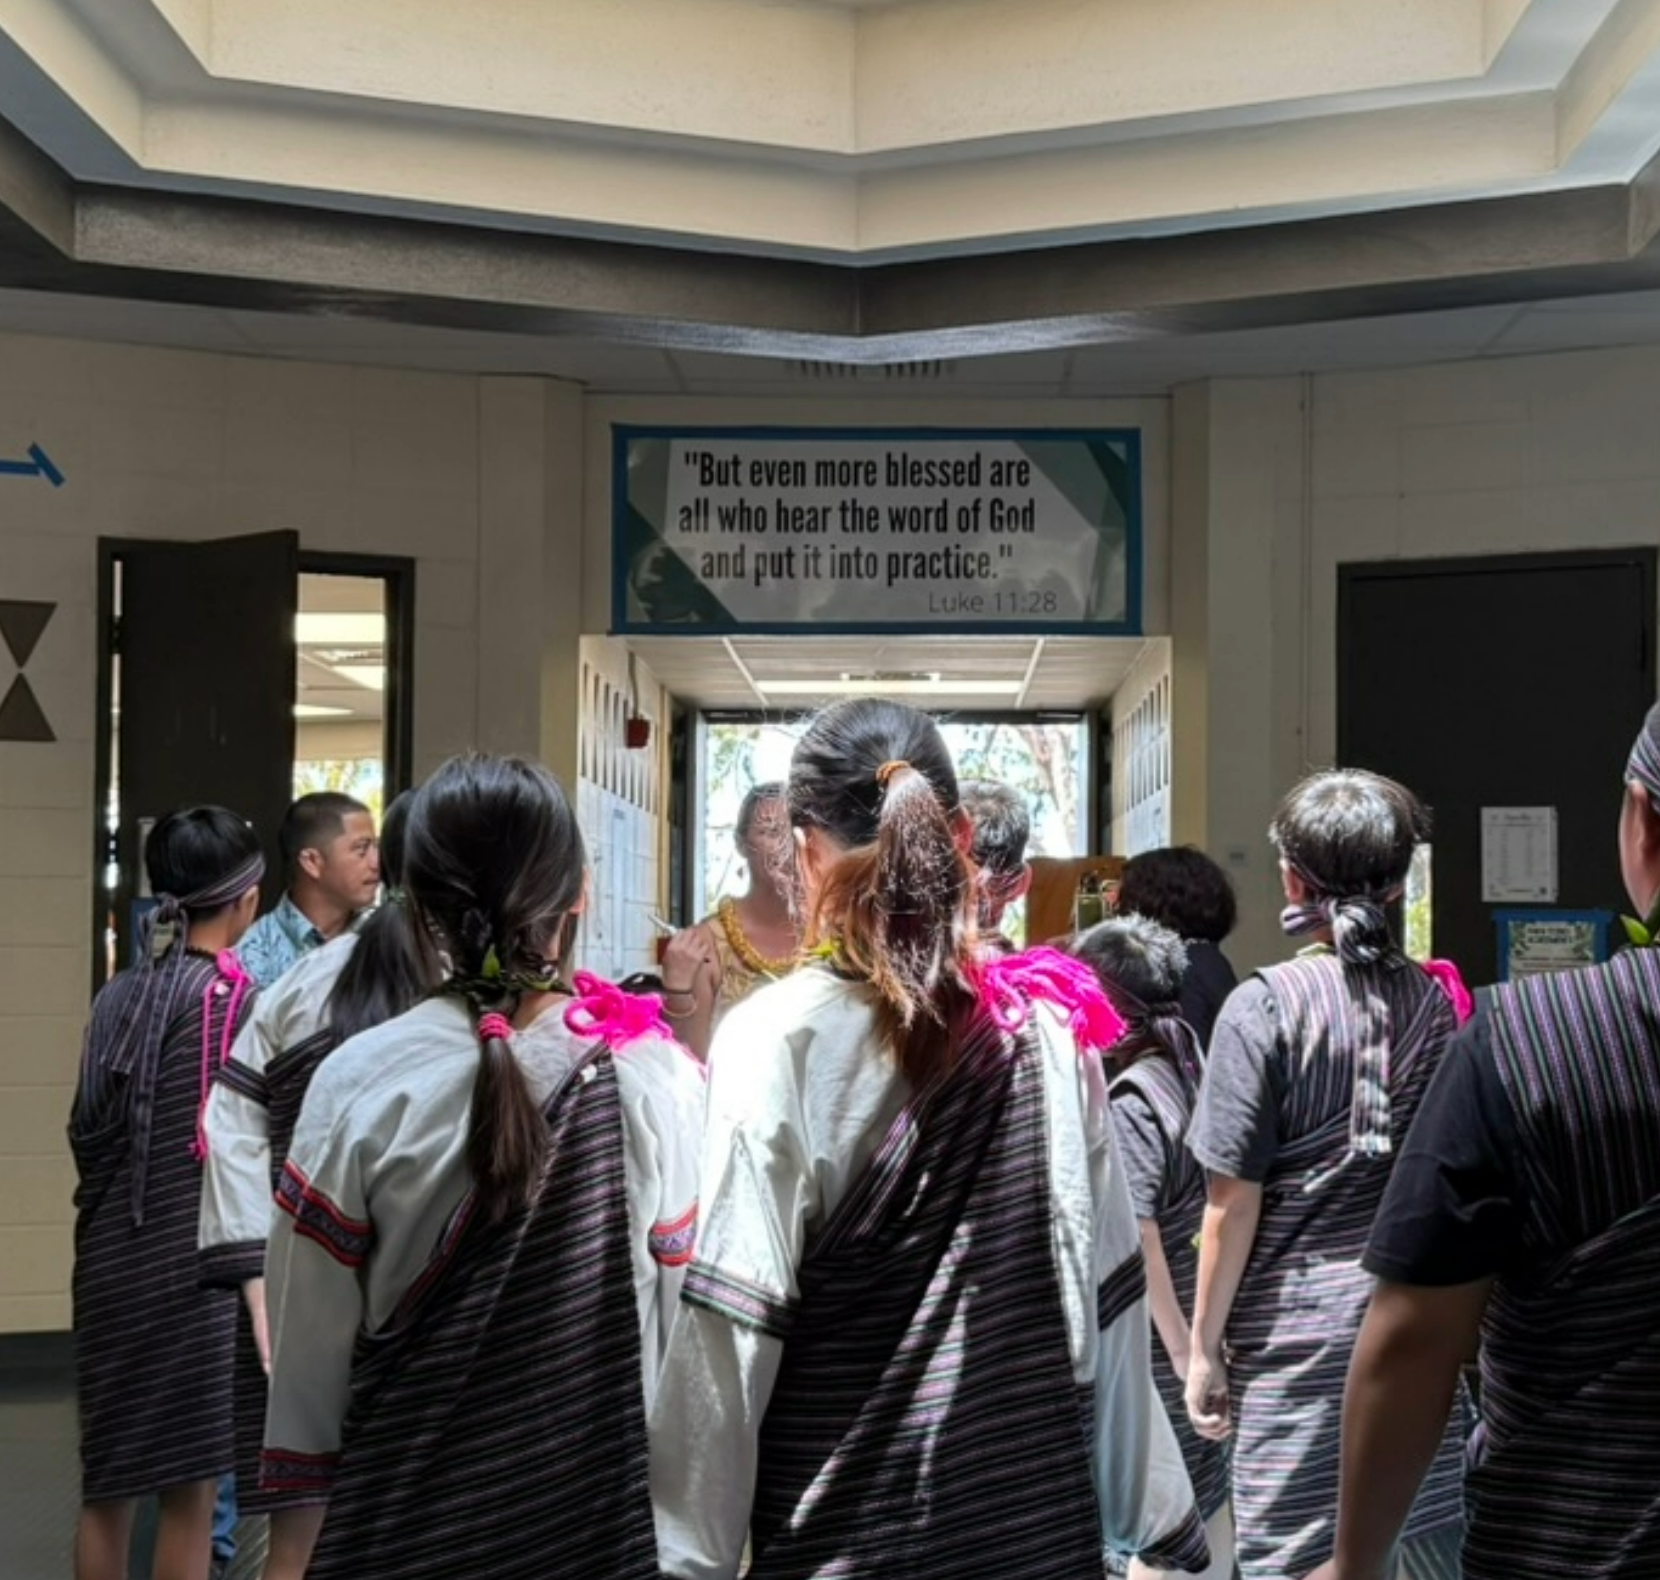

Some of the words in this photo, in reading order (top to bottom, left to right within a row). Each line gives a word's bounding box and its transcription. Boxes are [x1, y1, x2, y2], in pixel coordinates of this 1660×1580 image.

[684, 451, 742, 488] "But
[749, 459, 807, 488] even
[814, 459, 878, 488] more
[885, 451, 982, 488] blessed
[989, 459, 1031, 488] are
[678, 497, 710, 534] all
[717, 497, 768, 534] who
[775, 497, 833, 534] hear
[839, 497, 880, 534] the
[887, 497, 949, 534] word
[956, 497, 983, 534] of
[989, 497, 1036, 534] God
[700, 543, 746, 580] and
[754, 545, 796, 588] put
[803, 543, 822, 580] it
[829, 543, 878, 580] into
[887, 543, 1014, 588] practice."
[928, 591, 985, 614] Luke
[994, 590, 1058, 614] 11:28
